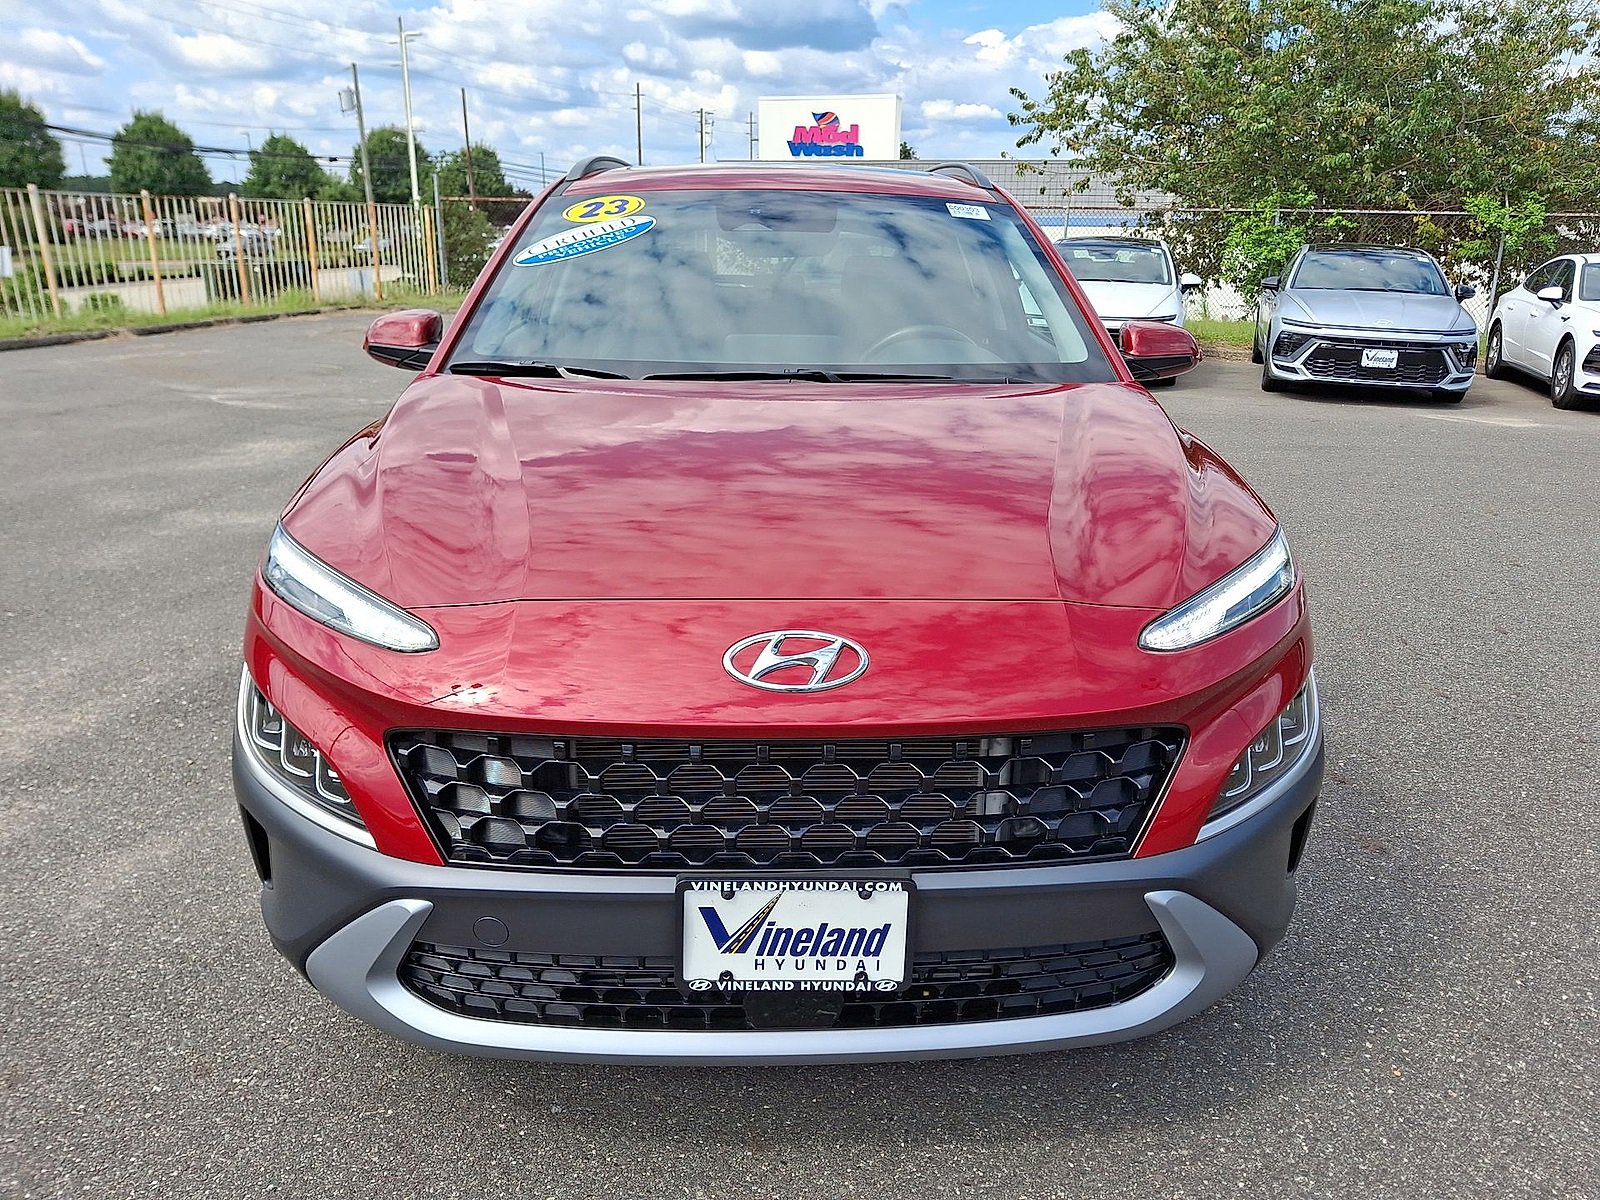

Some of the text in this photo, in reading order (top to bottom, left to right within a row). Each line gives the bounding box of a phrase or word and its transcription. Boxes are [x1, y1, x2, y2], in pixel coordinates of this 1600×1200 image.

[786, 140, 864, 156] Wash
[578, 199, 630, 218] 23
[528, 218, 636, 255] CERTIFIED
[538, 226, 638, 259] PRE-OWNED
[555, 232, 627, 257] VEHICLE
[691, 881, 903, 892] VINELANDHYUNDAI.COM
[698, 891, 892, 957] Vineland
[754, 959, 880, 971] HYUNDAI
[717, 981, 871, 991] VINELAND HYUNDAI
